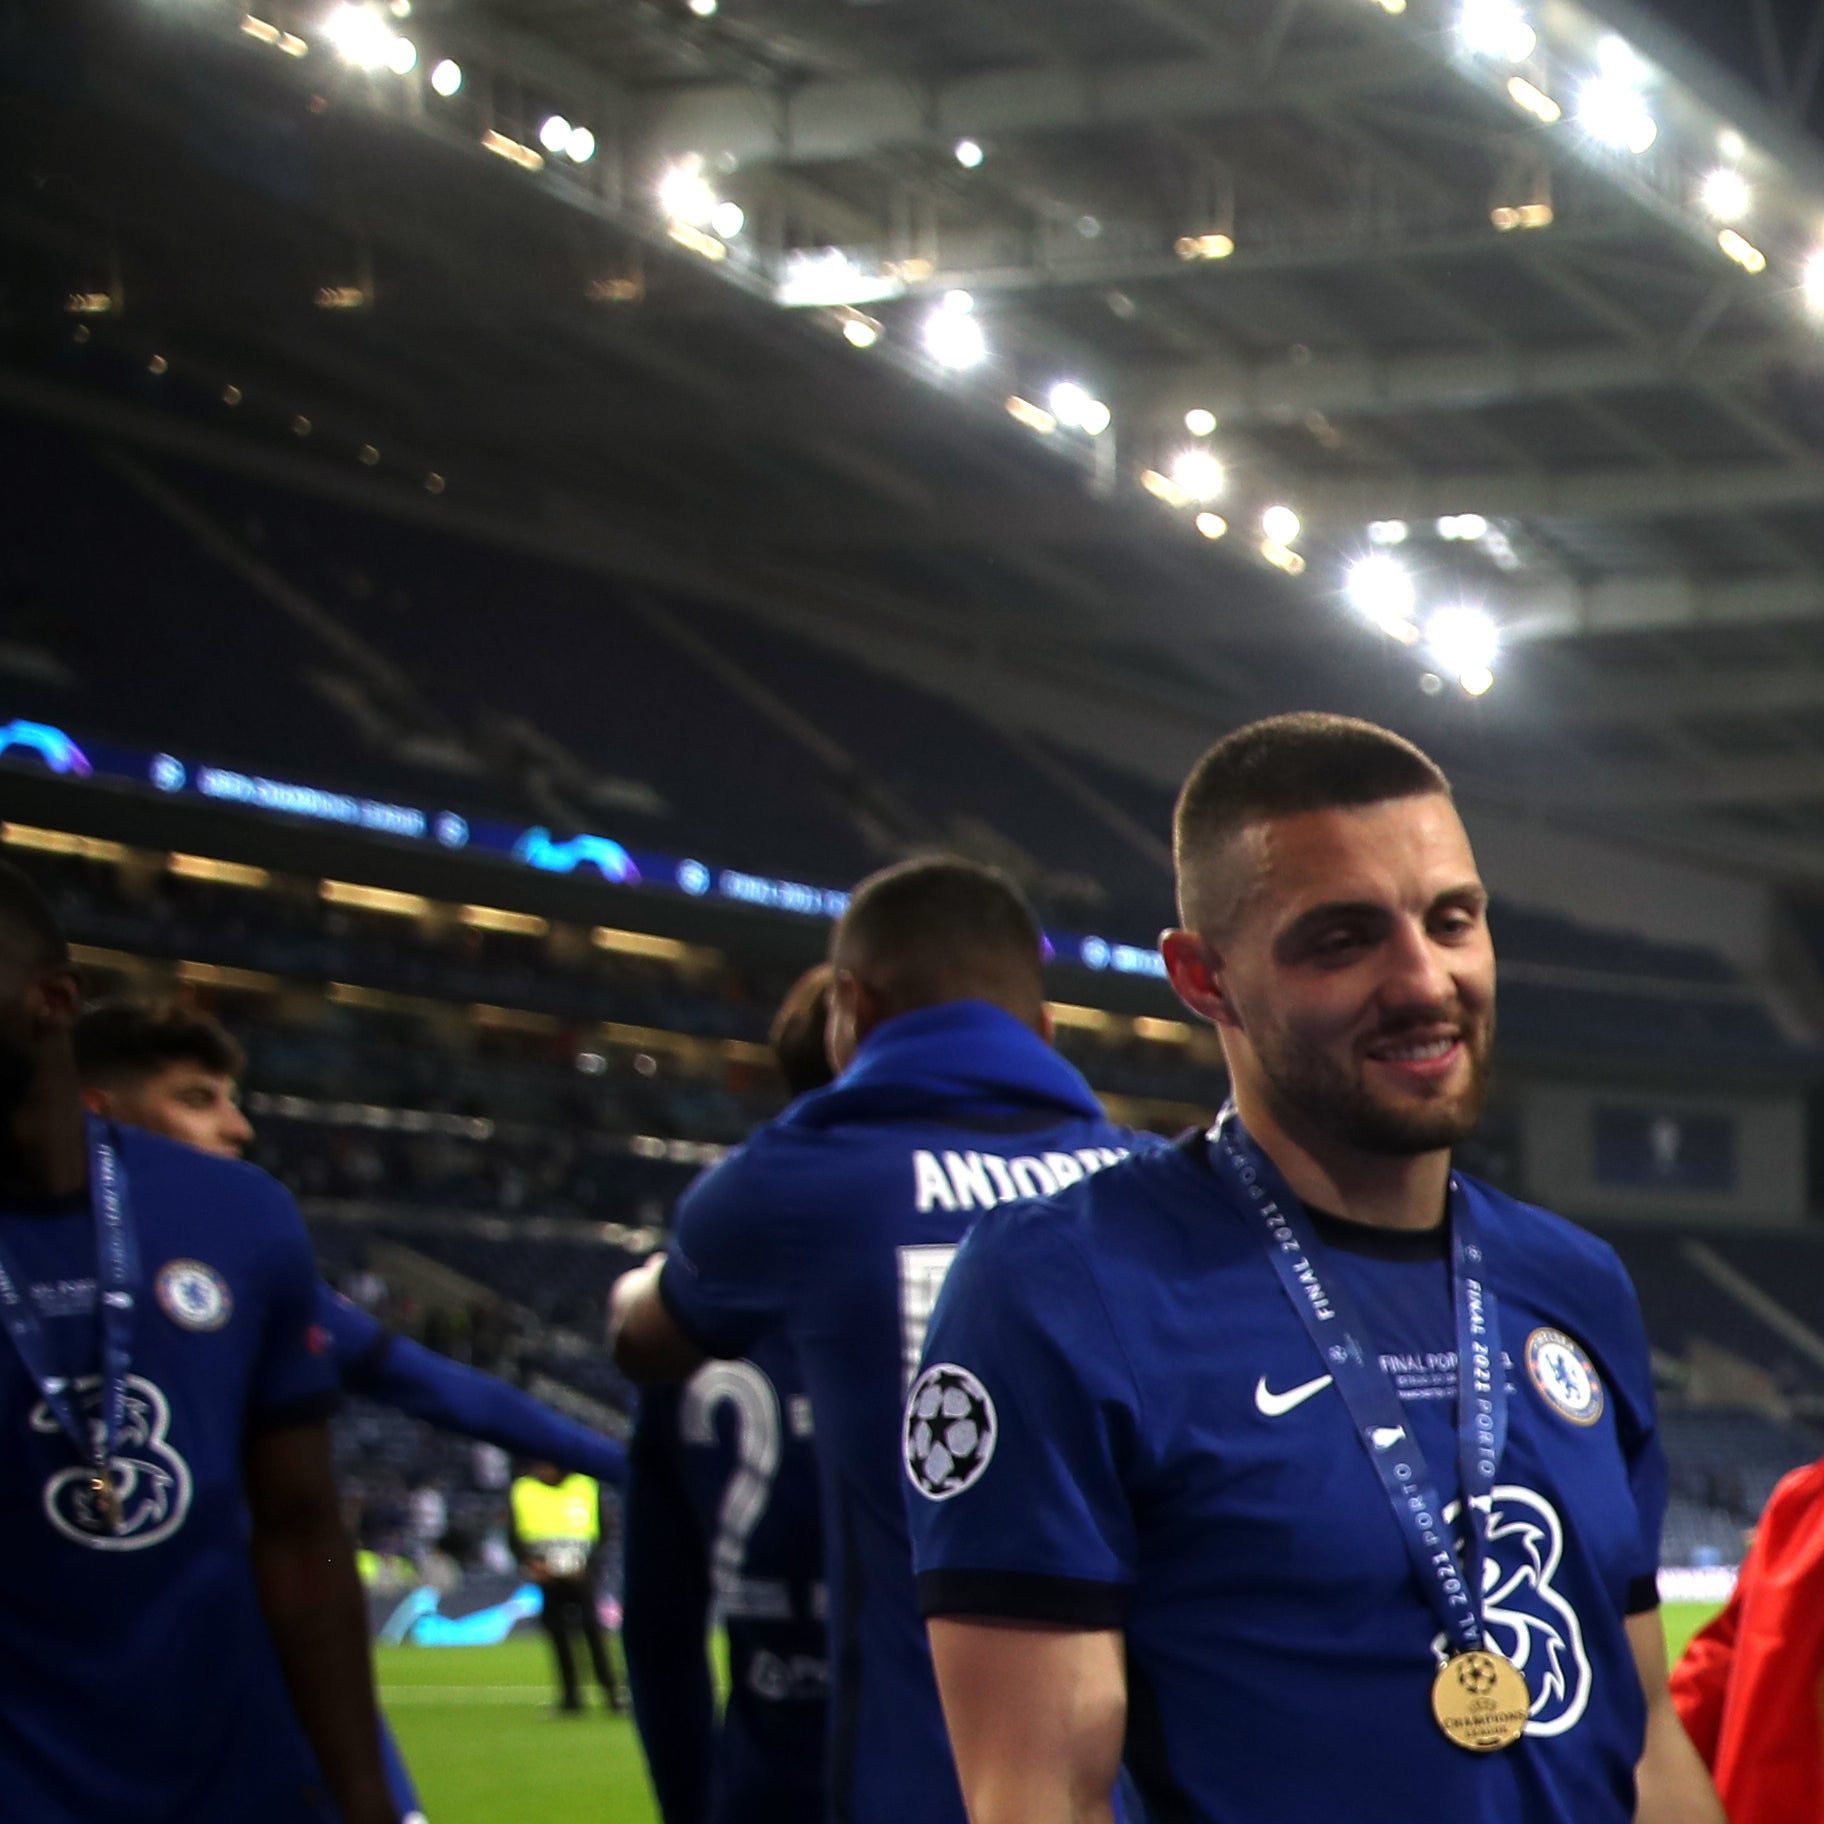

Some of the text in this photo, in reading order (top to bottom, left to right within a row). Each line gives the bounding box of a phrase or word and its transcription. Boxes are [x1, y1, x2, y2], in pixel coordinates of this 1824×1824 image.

[1259, 1201, 1301, 1253] 2021
[1293, 1255, 1336, 1323] FINAL
[1378, 1351, 1429, 1377] FINAL
[1465, 1277, 1497, 1478] FINAL 2021 PORTO
[1392, 1461, 1442, 1547] PORTO
[1432, 1550, 1469, 1607] 2021
